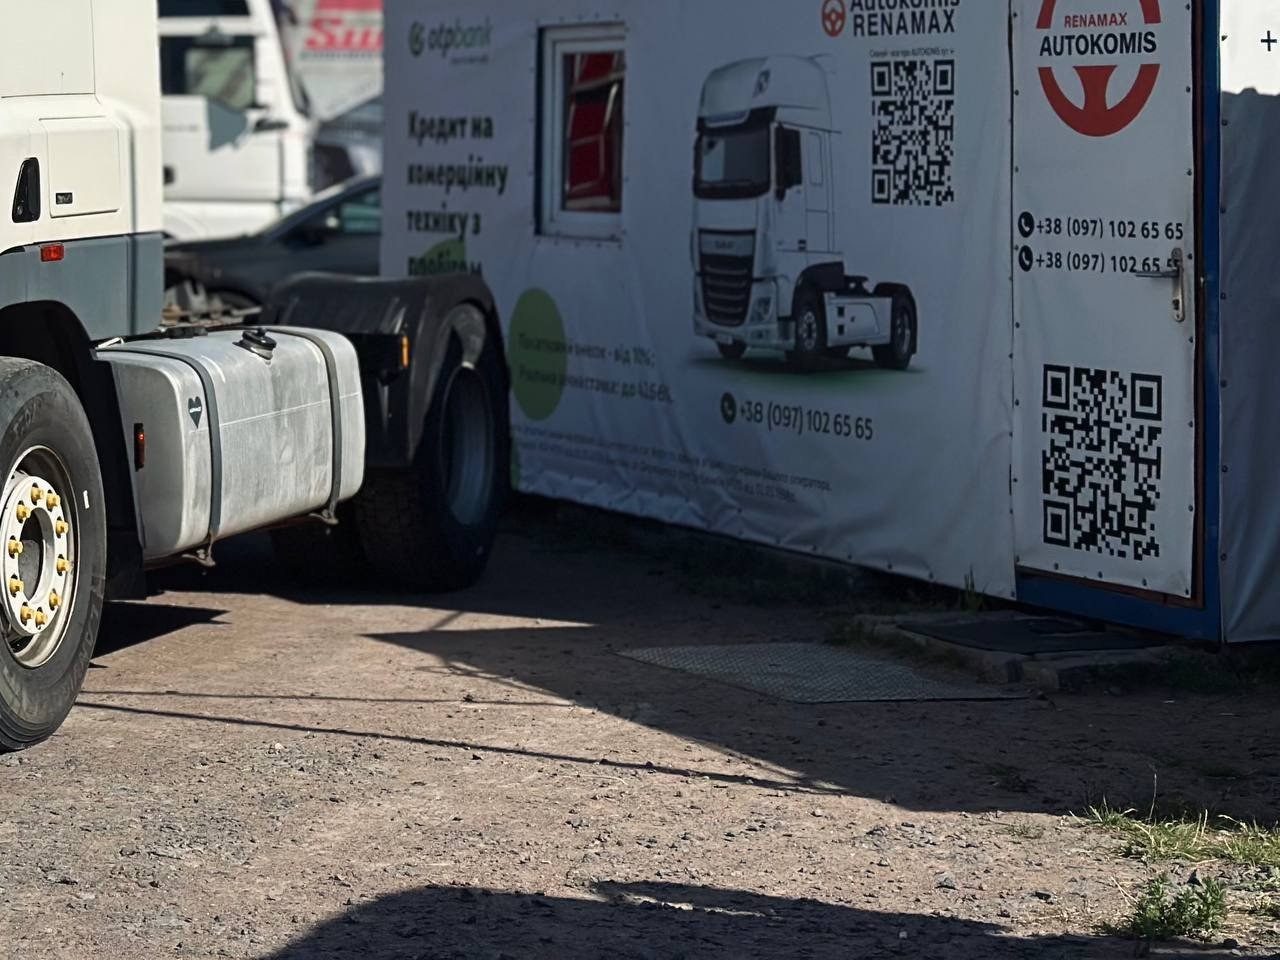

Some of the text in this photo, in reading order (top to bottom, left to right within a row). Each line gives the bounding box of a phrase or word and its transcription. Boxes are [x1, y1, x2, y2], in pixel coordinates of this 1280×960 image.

[853, 9, 955, 37] RENAMAX
[1064, 12, 1128, 29] RENAMAX
[1039, 31, 1157, 57] AUTOKOMIS
[408, 110, 494, 146] Кредит на
[407, 154, 508, 196] комерційну
[406, 201, 481, 242] техніку з
[1036, 217, 1184, 240] +38 (097) 102 65 65
[1036, 252, 1062, 269] +38
[1067, 251, 1105, 273] (097)
[1111, 255, 1137, 273] 102
[1142, 257, 1160, 272] 65
[740, 401, 873, 441] +38 (097) 102 65 65
